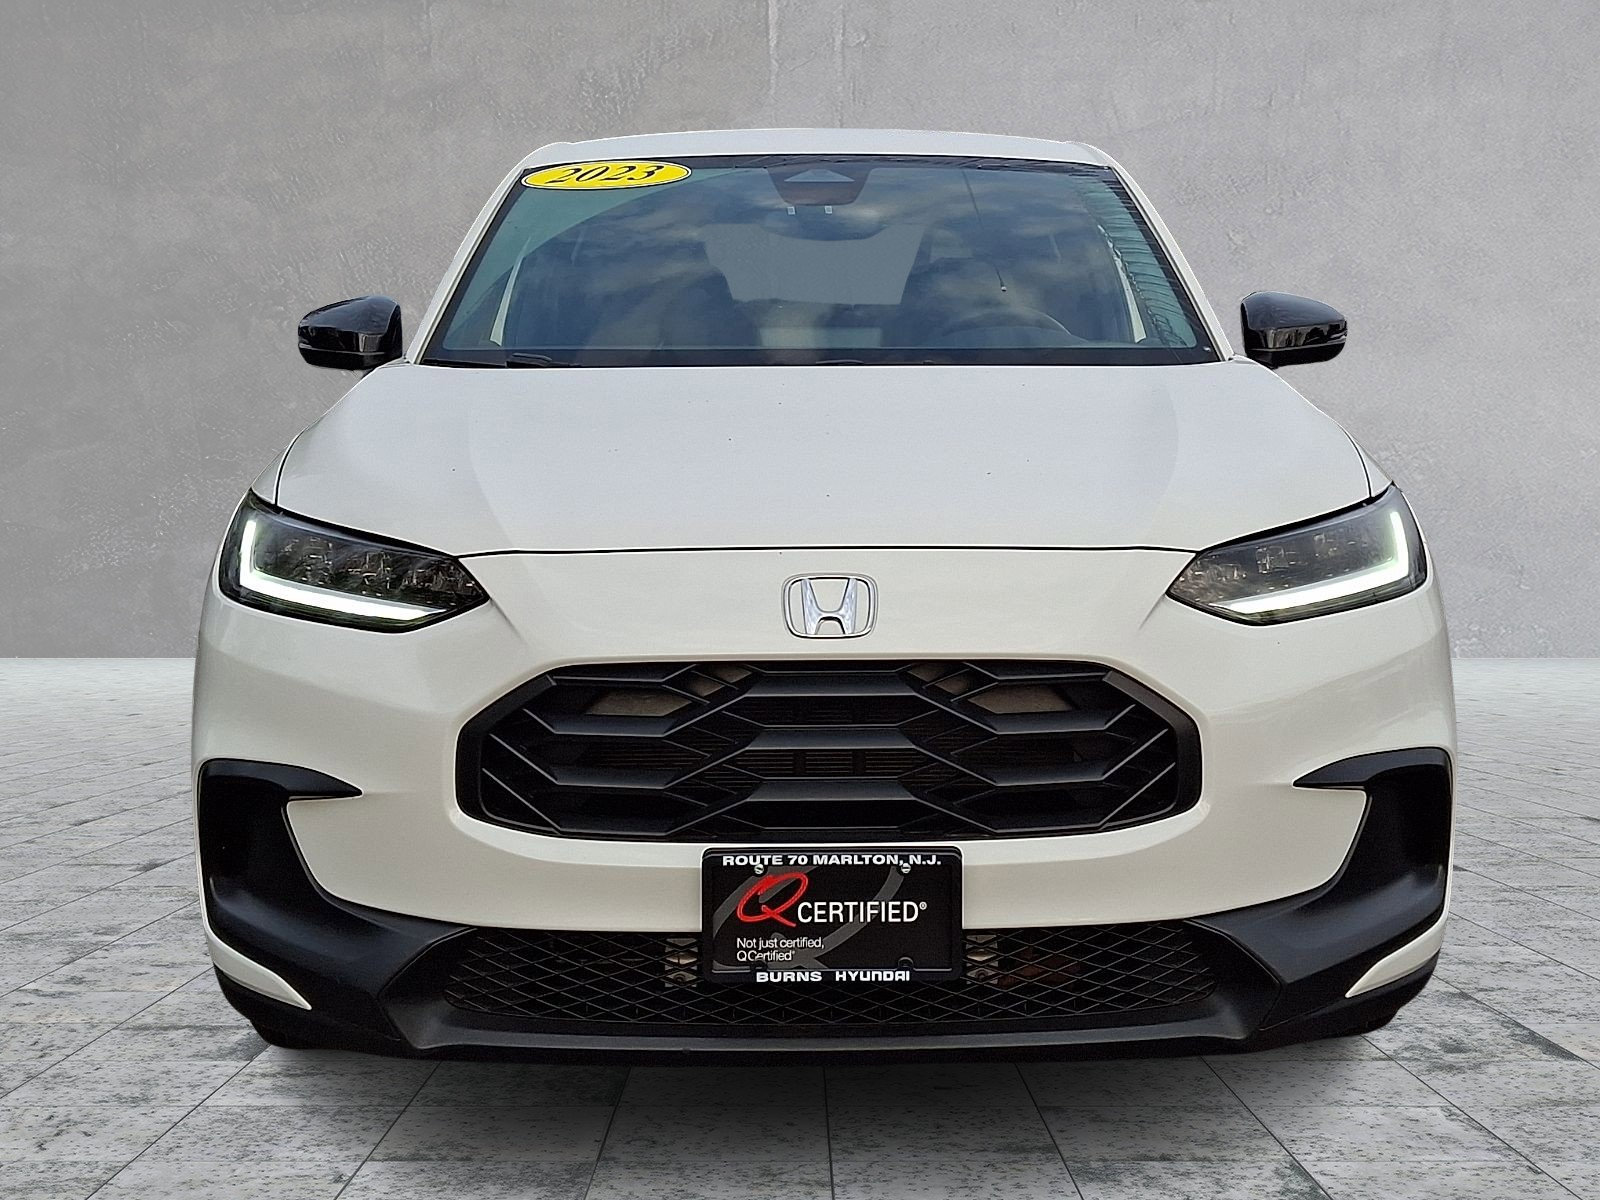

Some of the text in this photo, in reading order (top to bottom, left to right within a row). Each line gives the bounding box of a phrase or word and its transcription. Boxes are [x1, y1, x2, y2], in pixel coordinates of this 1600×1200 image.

[544, 165, 665, 184] 2023
[722, 854, 942, 866] ROUTE 70 MARLTON, N.J.
[736, 937, 825, 951] Not just certified,
[756, 971, 911, 983] BURNS HYUNDAI
